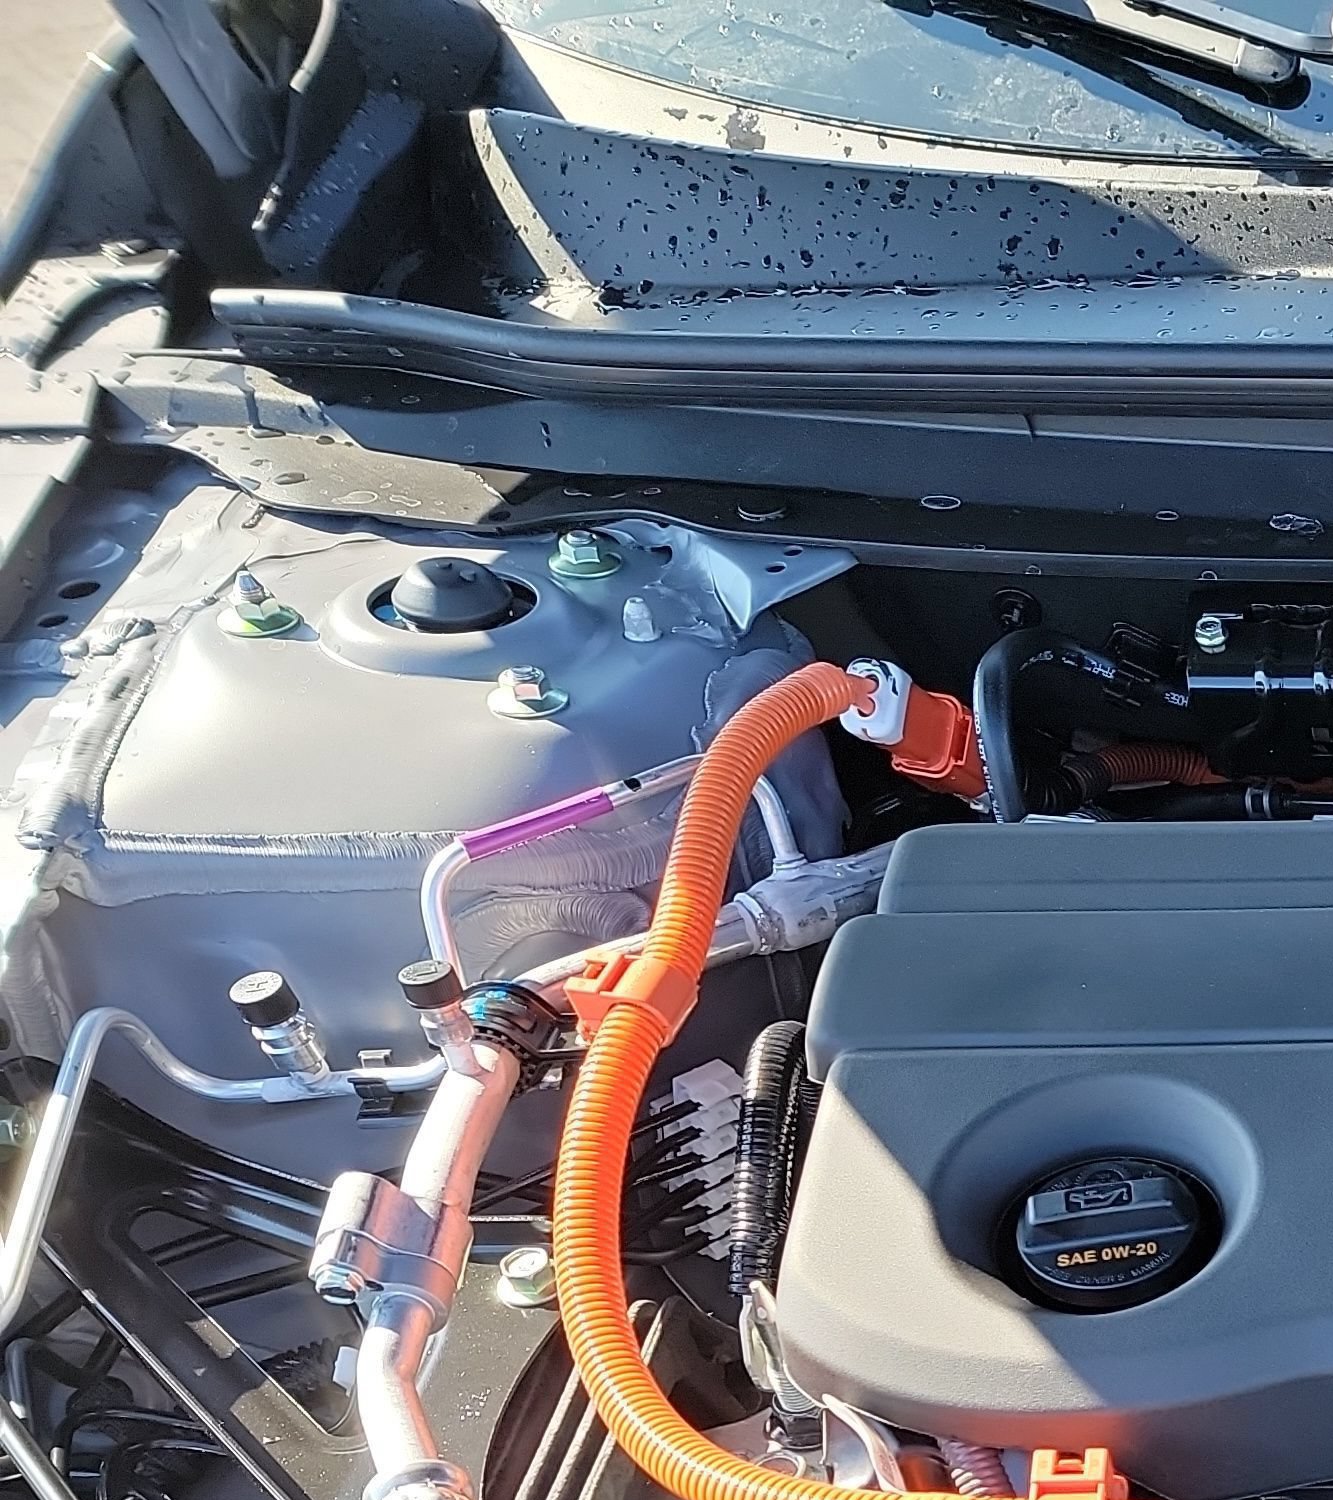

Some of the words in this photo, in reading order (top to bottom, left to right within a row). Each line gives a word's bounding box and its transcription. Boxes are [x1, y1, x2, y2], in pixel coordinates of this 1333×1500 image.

[1057, 1251, 1096, 1267] SAE
[1101, 1241, 1157, 1260] 0W-20
[1131, 1251, 1169, 1276] MANUAL
